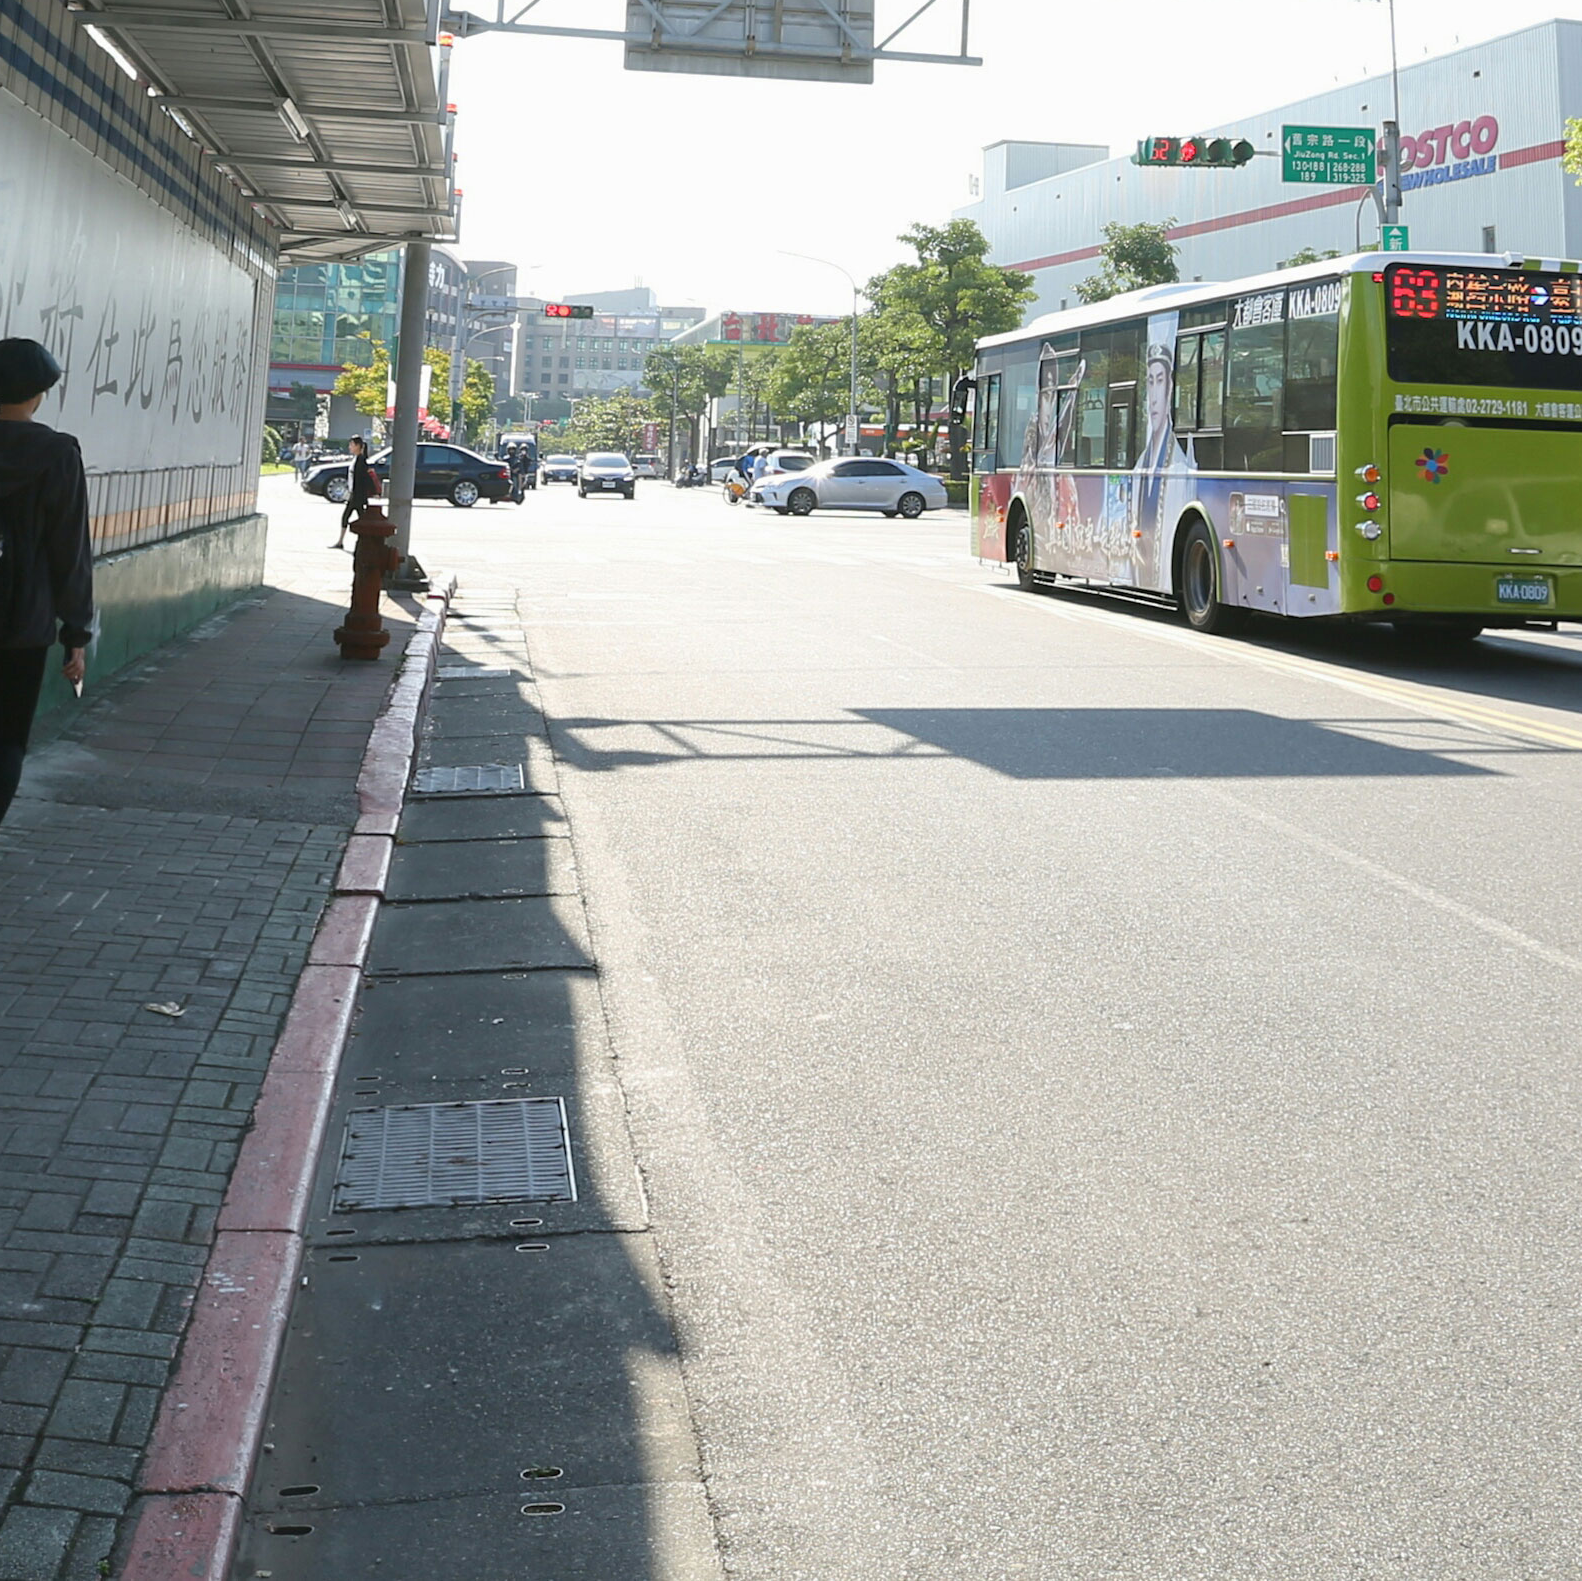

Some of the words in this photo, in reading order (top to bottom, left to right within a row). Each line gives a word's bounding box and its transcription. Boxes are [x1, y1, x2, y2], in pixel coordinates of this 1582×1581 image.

[1291, 133, 1367, 148] 舊宗路一段
[1328, 151, 1340, 160] Rd.
[1343, 152, 1360, 160] Sec.
[1300, 171, 1317, 181] 189
[1407, 155, 1497, 190] WHOLESALE
[1288, 282, 1341, 319] KKA-0809
[1392, 268, 1440, 318] 63
[1498, 583, 1548, 600] KKA-0809
